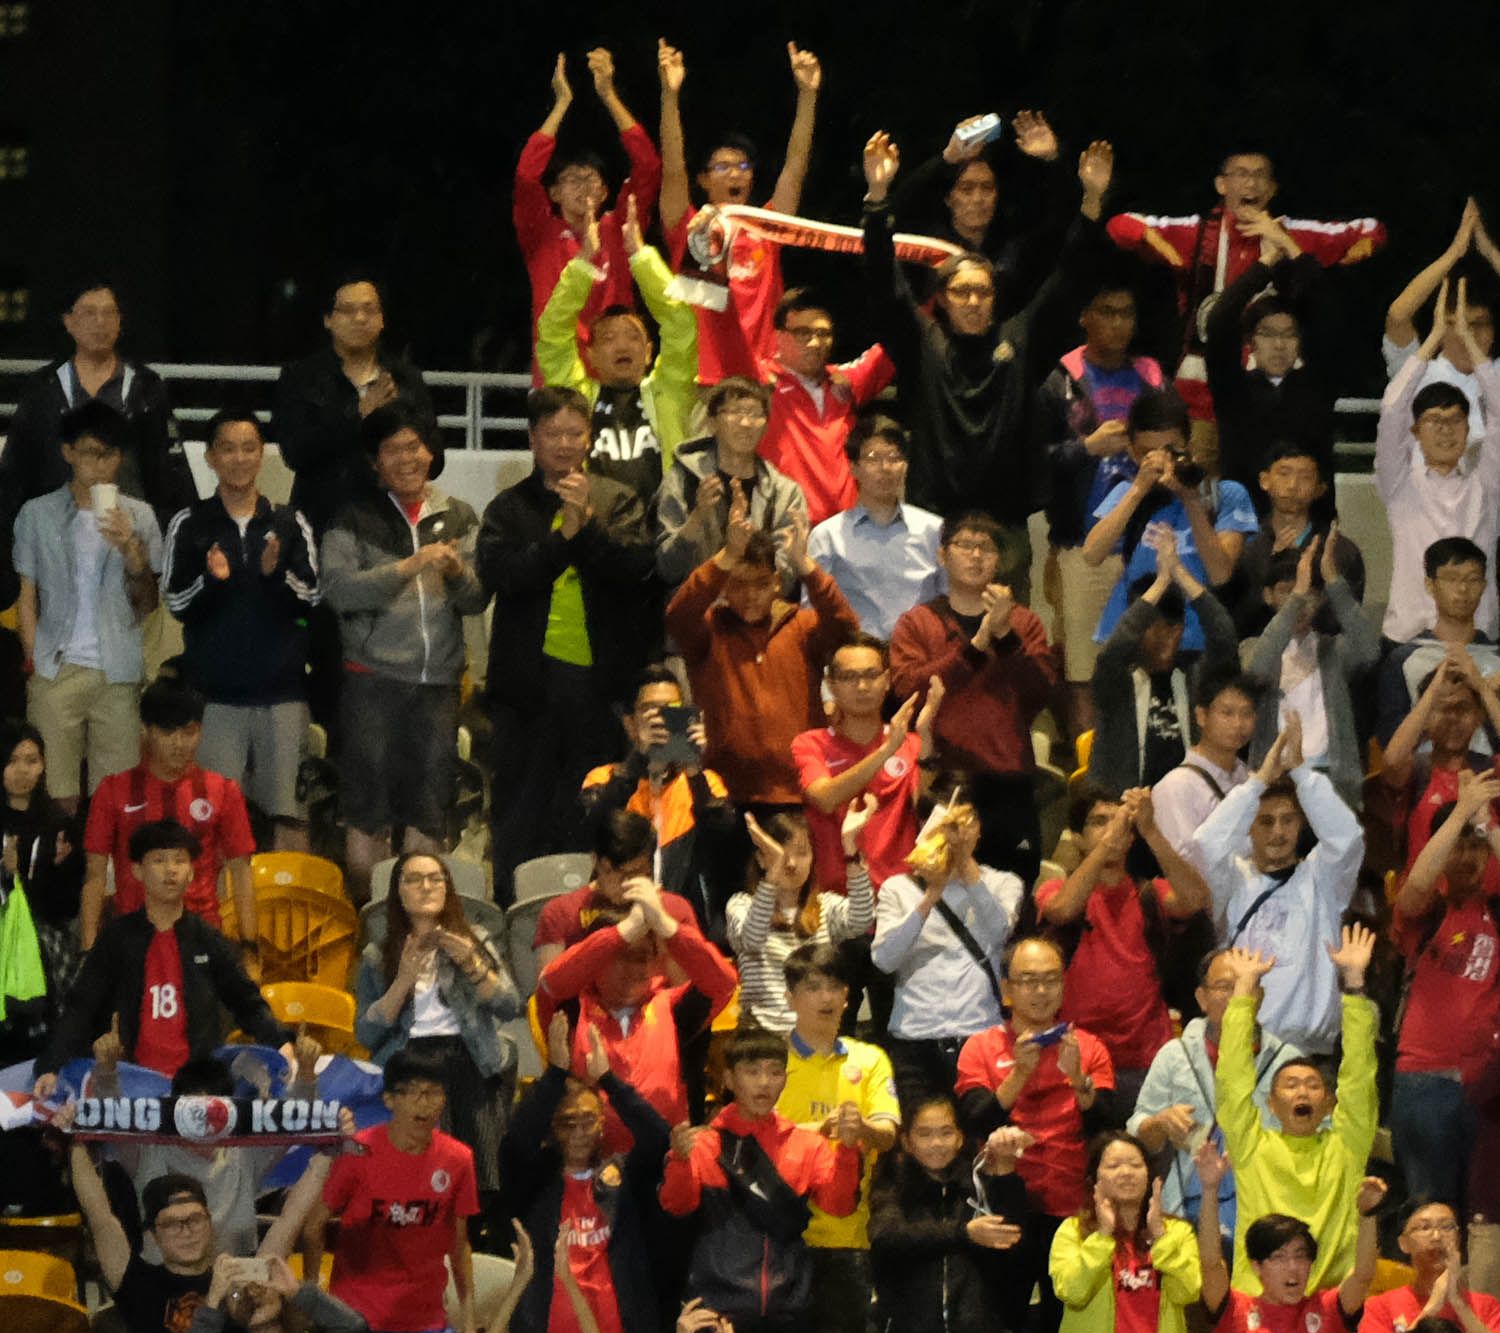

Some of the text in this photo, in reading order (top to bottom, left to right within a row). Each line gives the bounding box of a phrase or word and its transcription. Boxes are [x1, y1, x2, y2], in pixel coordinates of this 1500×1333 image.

[149, 983, 178, 1020] 18
[78, 1098, 342, 1134] ONG KON
